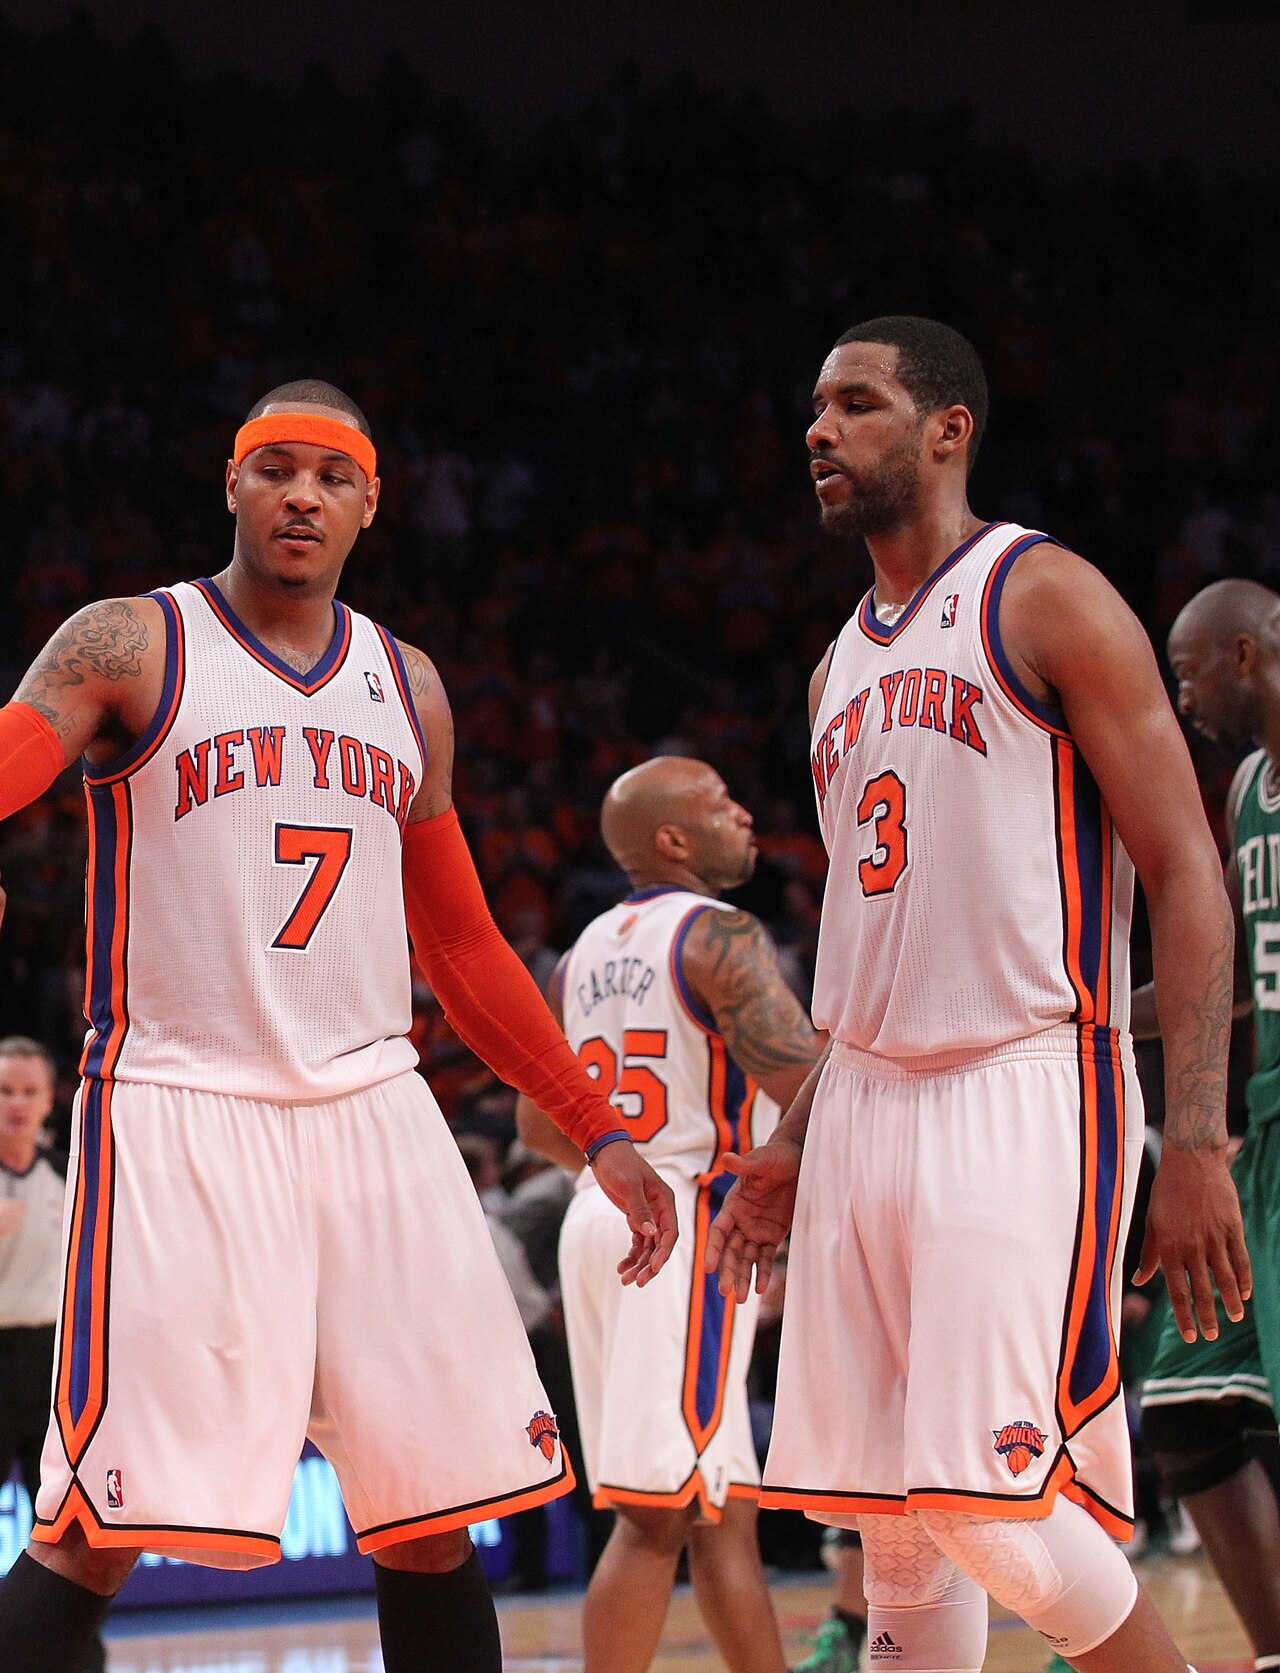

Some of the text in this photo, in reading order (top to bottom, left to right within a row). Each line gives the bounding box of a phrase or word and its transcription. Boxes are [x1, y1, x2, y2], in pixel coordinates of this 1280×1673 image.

[174, 726, 416, 832] NEW YORK
[811, 667, 988, 824] NEW YORK
[270, 822, 354, 951] 7
[856, 768, 909, 899] 3
[577, 957, 656, 1017] CARTER
[994, 1425, 1044, 1453] KNICKS
[870, 1644, 903, 1653] adidas
